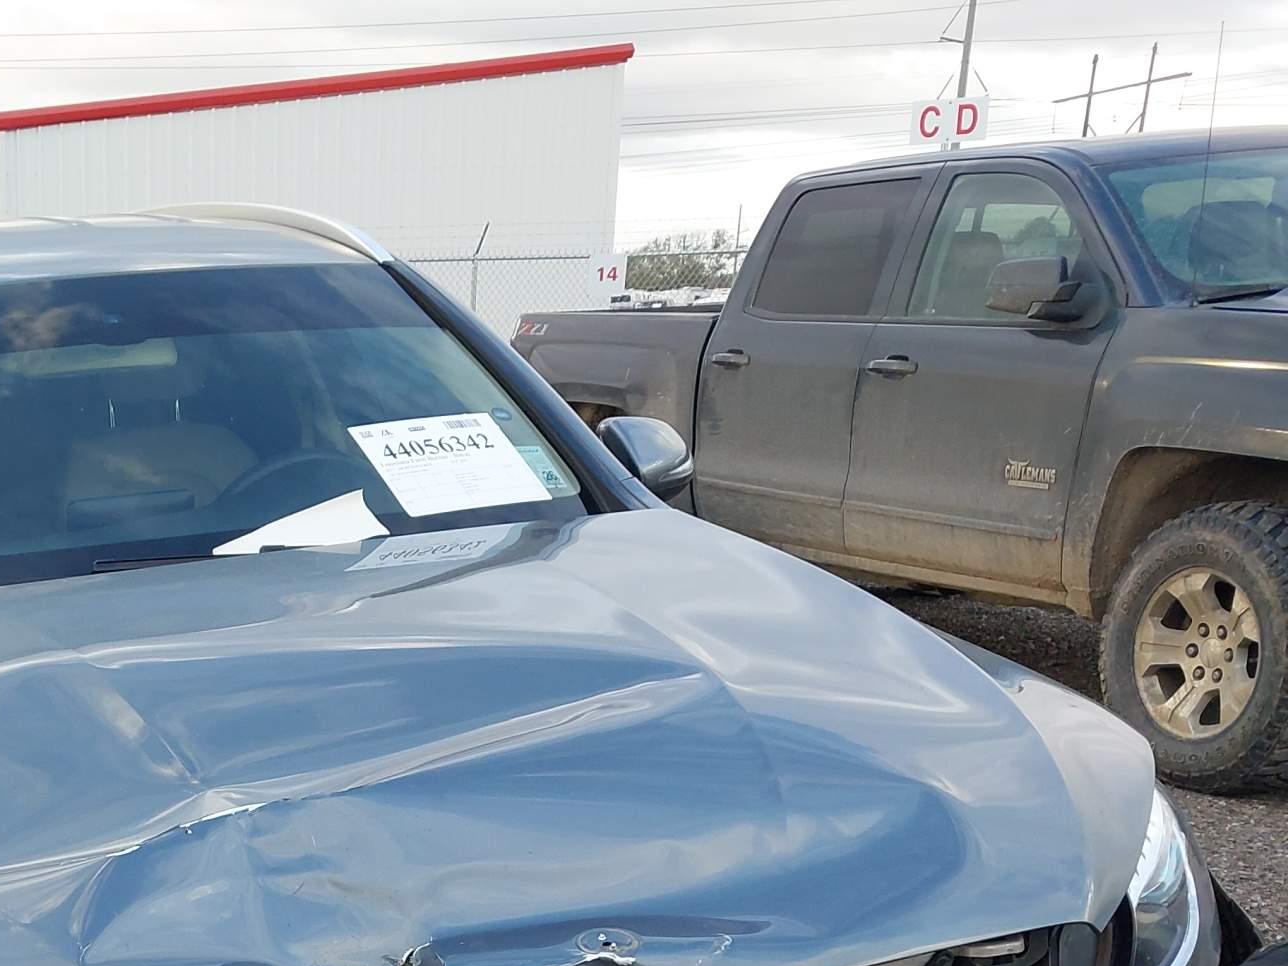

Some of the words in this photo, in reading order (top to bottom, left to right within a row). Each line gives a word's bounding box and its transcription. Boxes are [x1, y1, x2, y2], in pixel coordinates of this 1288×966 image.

[919, 105, 942, 139] C
[956, 103, 979, 136] D
[596, 266, 619, 282] 14
[517, 321, 549, 336] Z71
[383, 433, 495, 460] 44056342
